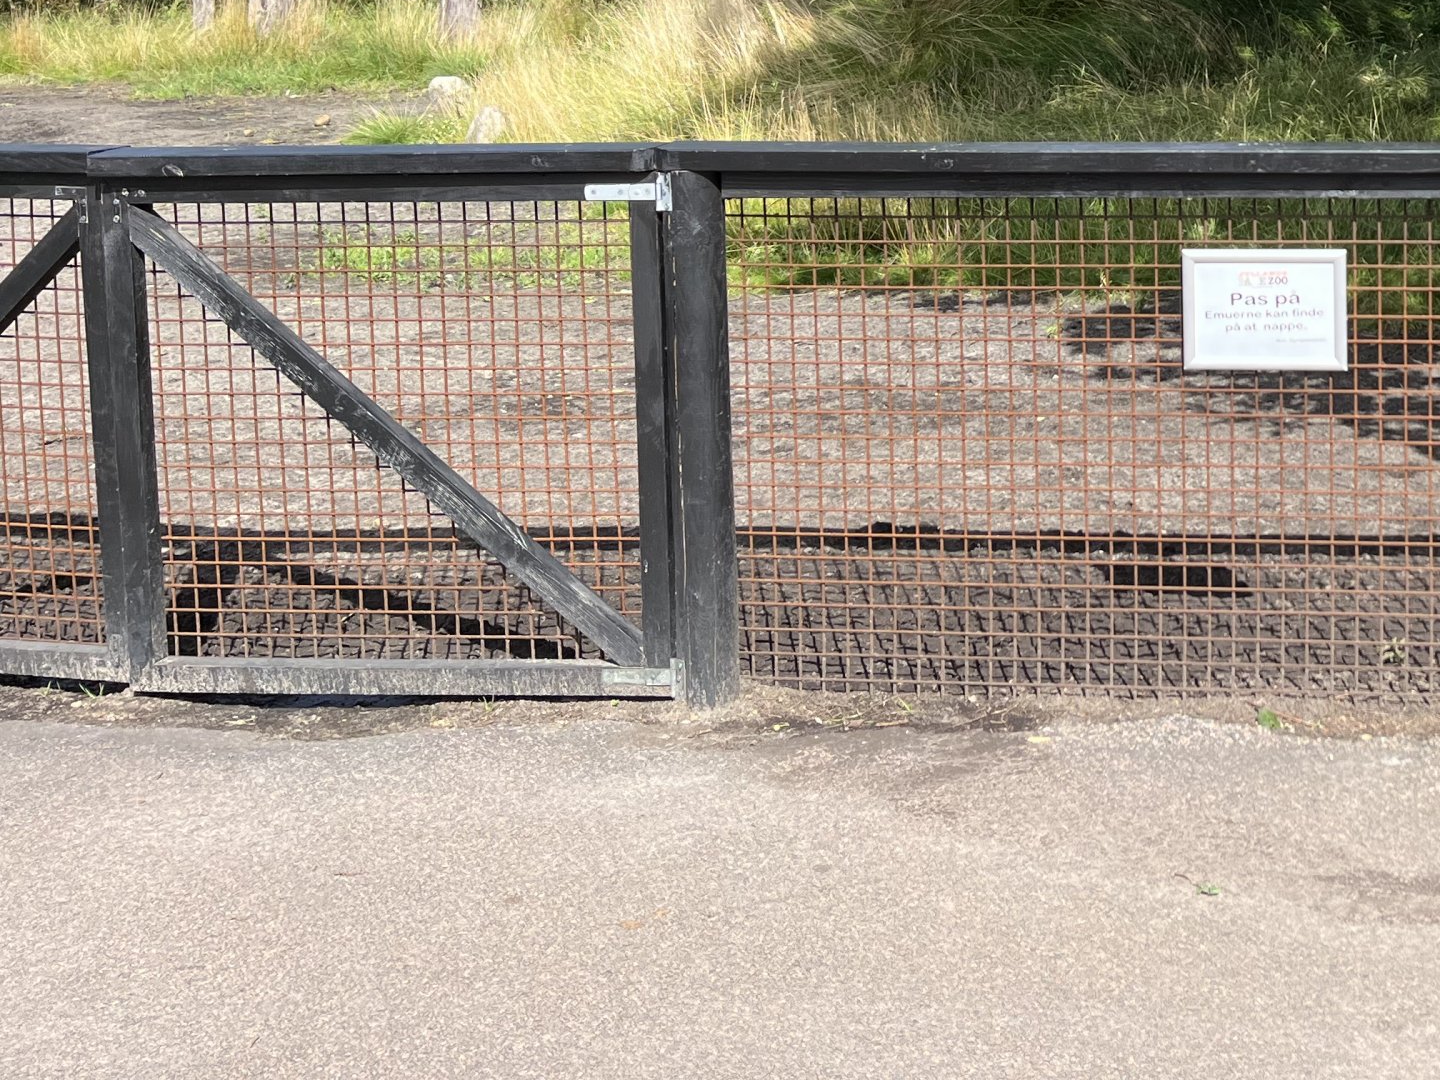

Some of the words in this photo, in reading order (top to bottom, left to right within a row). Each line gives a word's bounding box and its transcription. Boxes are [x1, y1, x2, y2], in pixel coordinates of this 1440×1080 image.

[1230, 292, 1268, 306] Pas
[1275, 289, 1301, 308] på
[1205, 310, 1262, 319] Emuerne
[1265, 309, 1288, 318] kan
[1292, 308, 1324, 317] finde
[1225, 322, 1241, 333] på
[1244, 323, 1257, 331] at
